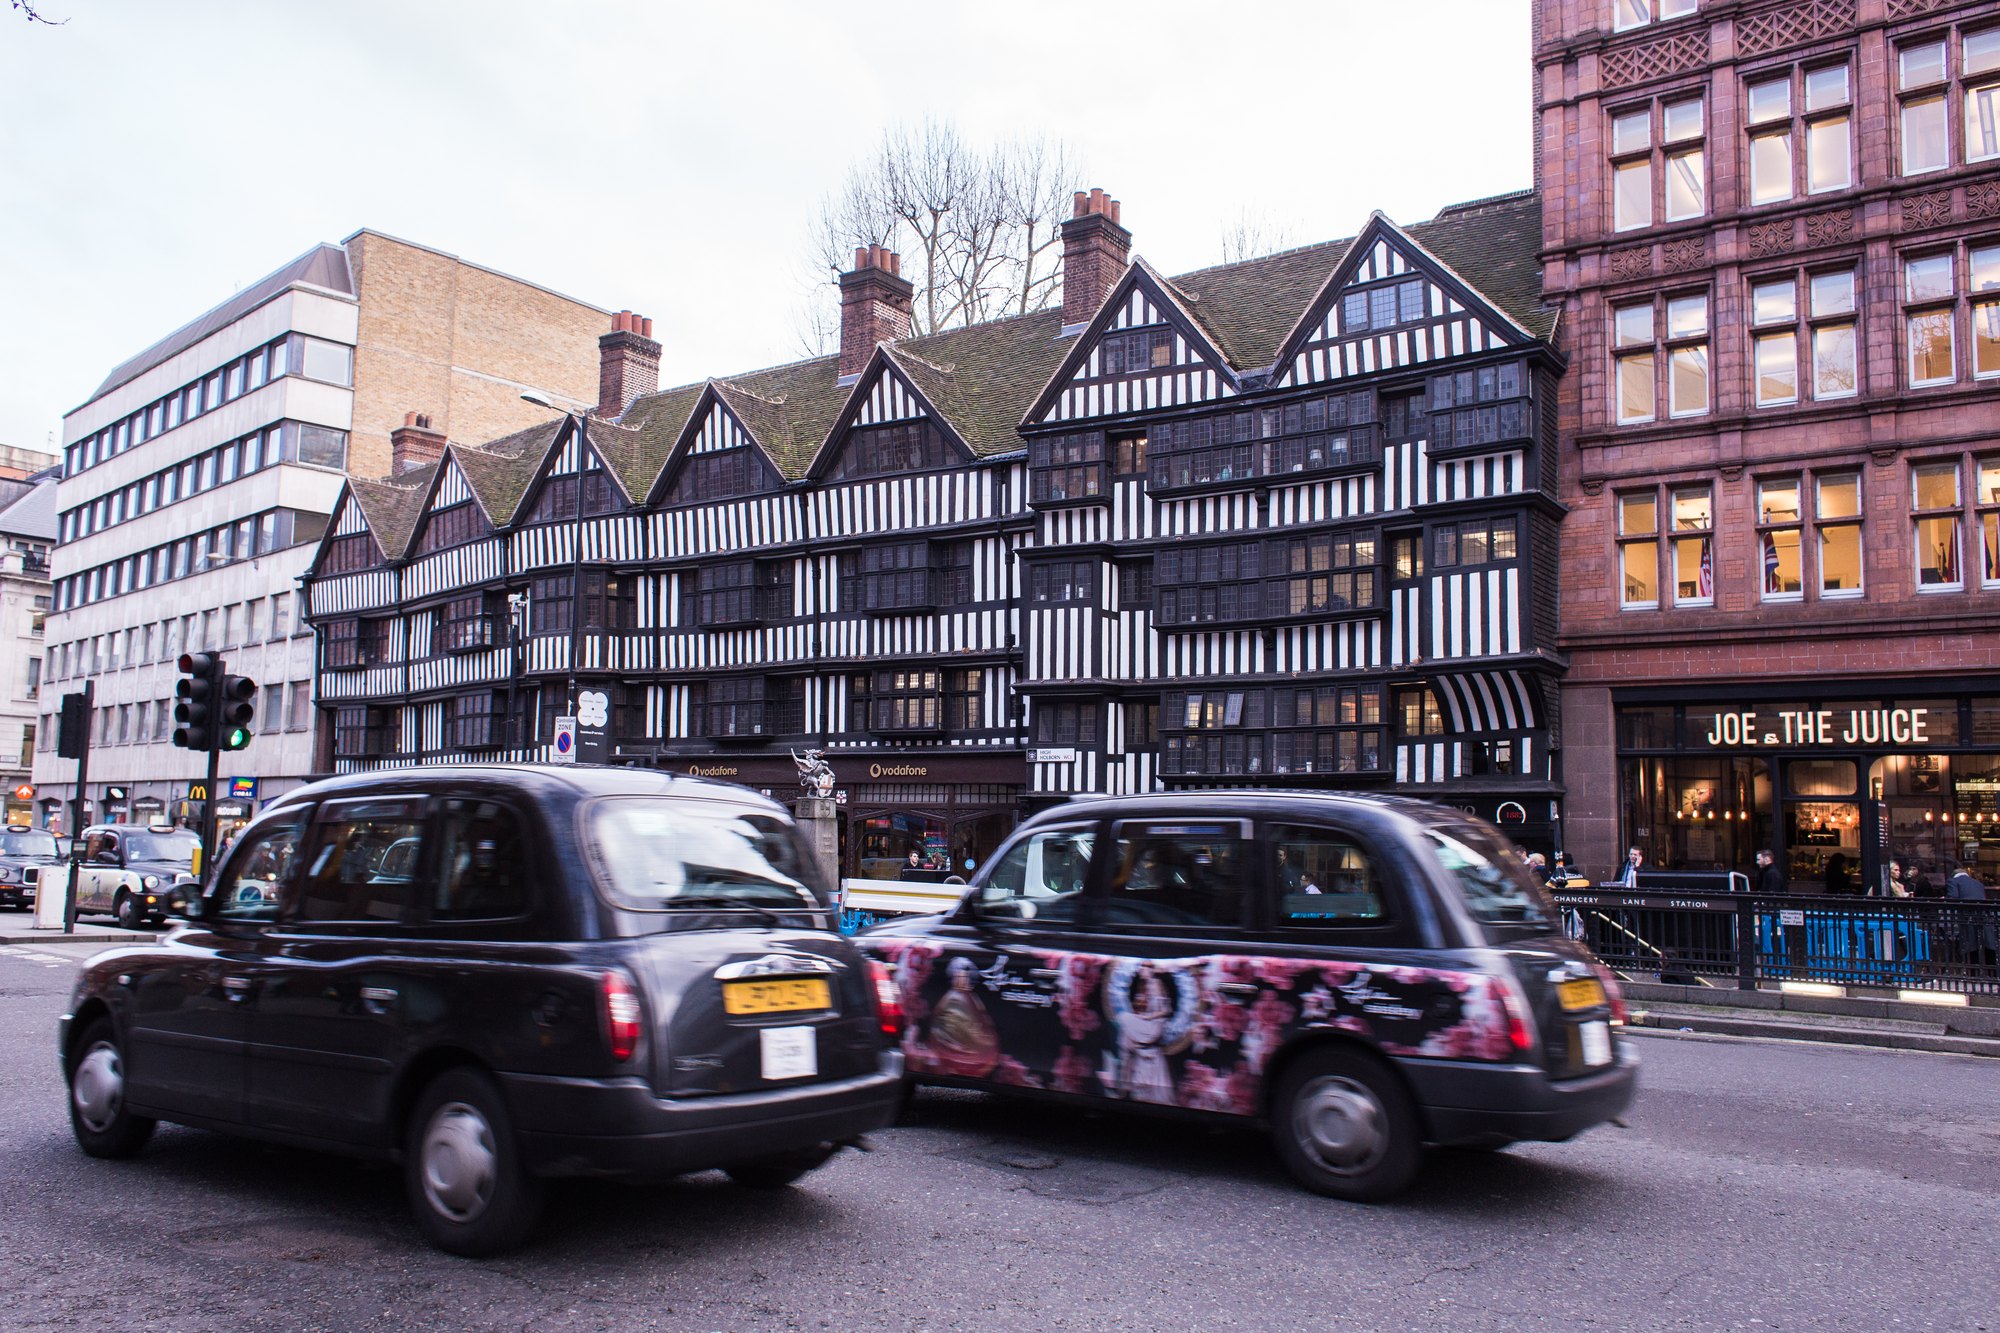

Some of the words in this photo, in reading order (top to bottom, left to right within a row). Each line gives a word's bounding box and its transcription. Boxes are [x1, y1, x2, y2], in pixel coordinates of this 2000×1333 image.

[1707, 712, 1757, 745] JOE
[1763, 733, 1779, 745] &
[1779, 711, 1833, 744] THE
[1843, 708, 1929, 743] JUICE
[699, 765, 738, 777] vodafone
[881, 765, 927, 777] vodafone
[1553, 895, 1599, 904] CHANCERY
[1622, 898, 1646, 906] LANE
[1670, 900, 1709, 908] STATION
